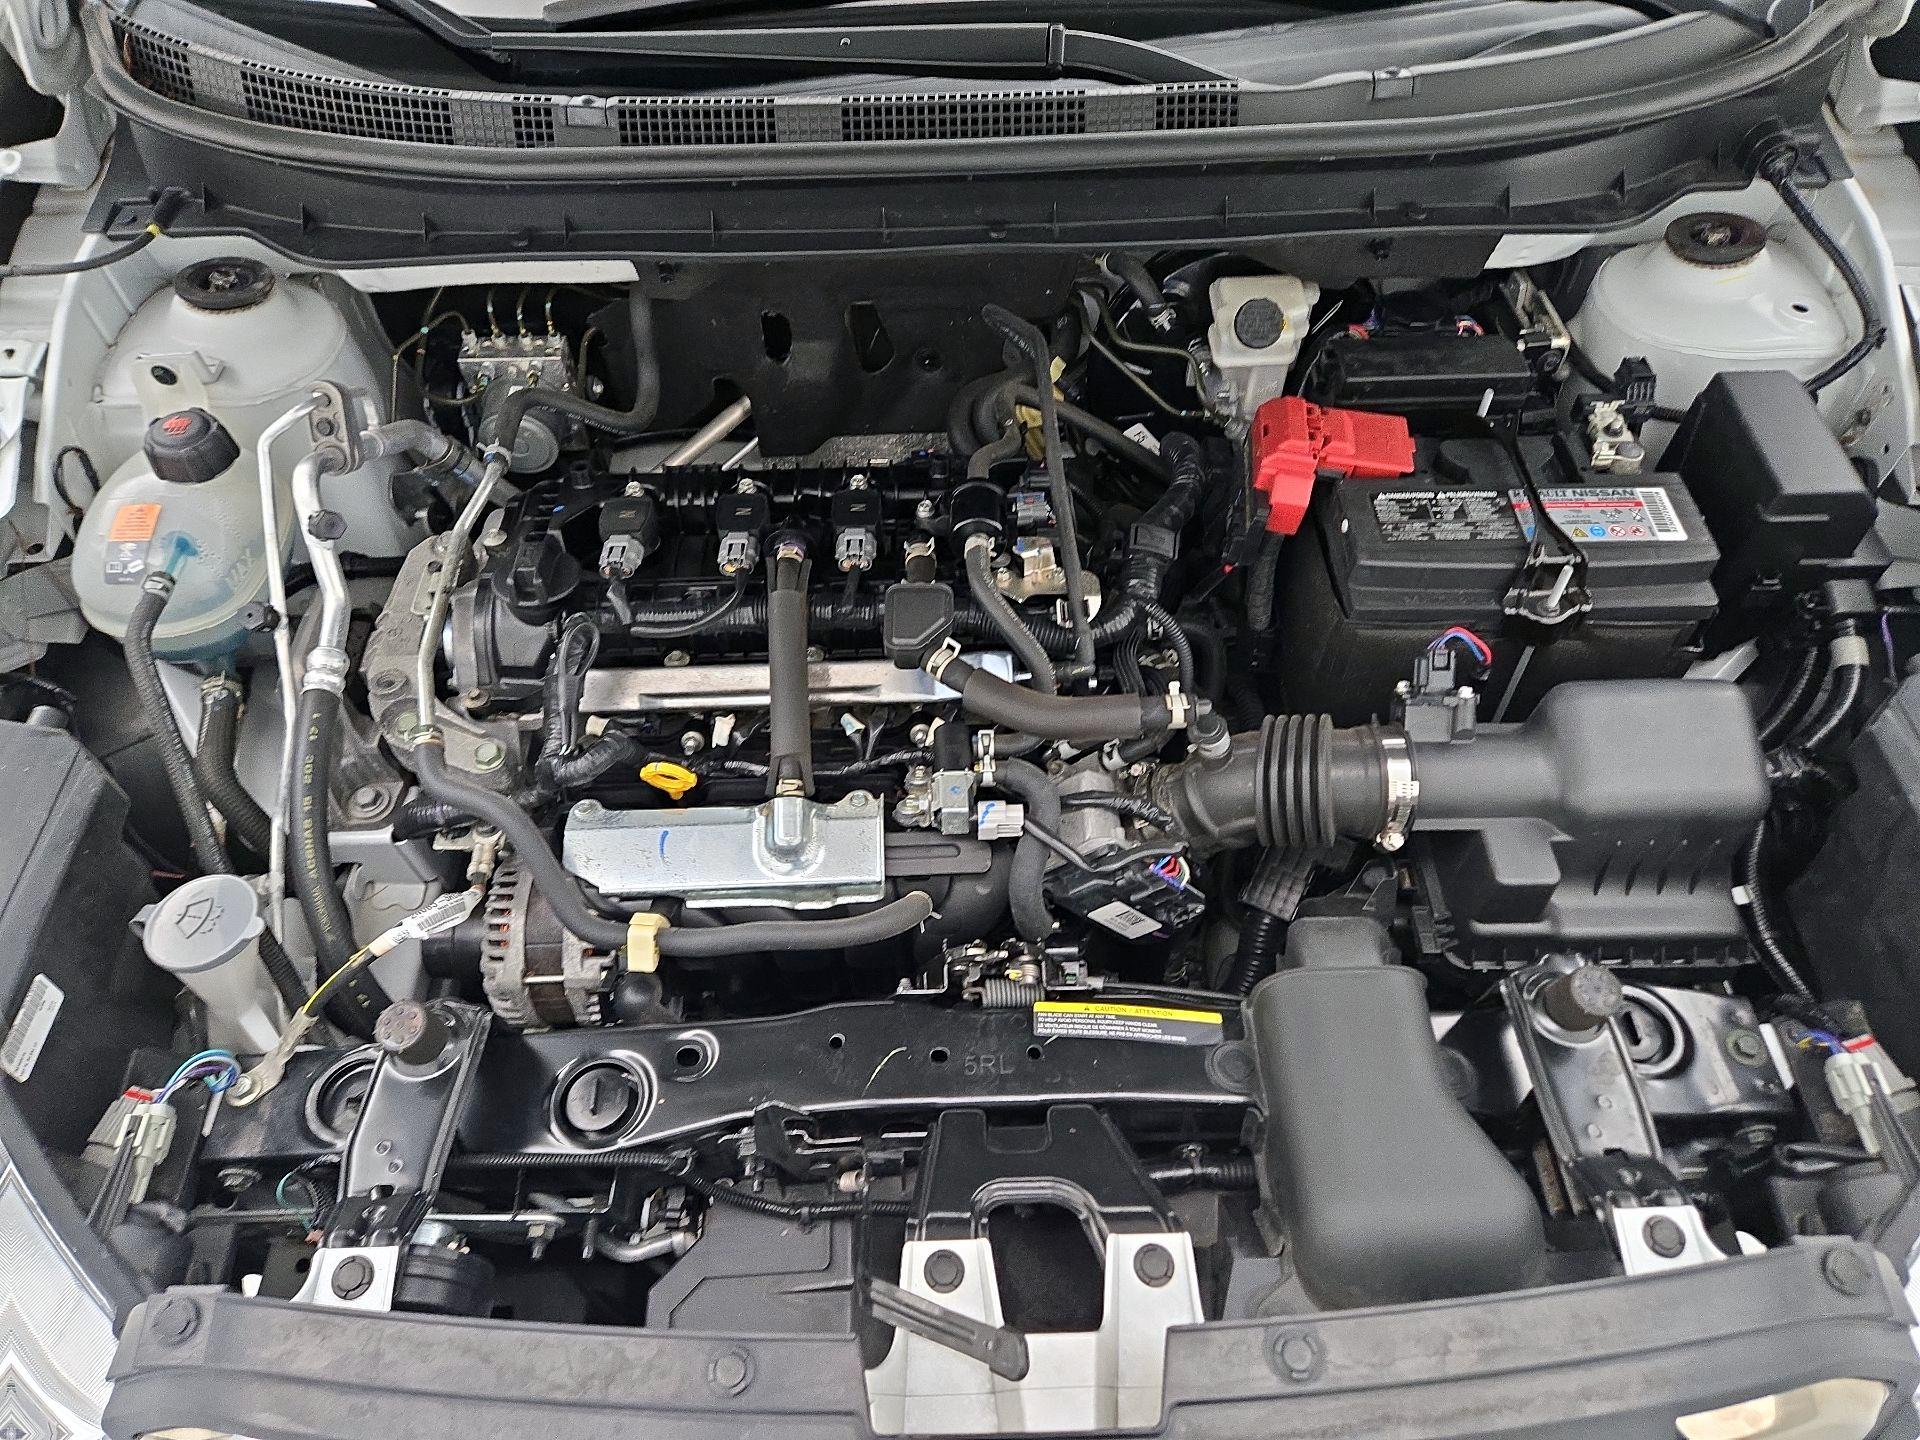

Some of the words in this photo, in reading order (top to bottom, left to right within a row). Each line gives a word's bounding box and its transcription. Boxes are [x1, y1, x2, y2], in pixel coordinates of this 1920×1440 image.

[1572, 489, 1635, 497] NISSAN
[1135, 1008, 1173, 1016] ATTENTION
[964, 1054, 1016, 1075] 5RL
